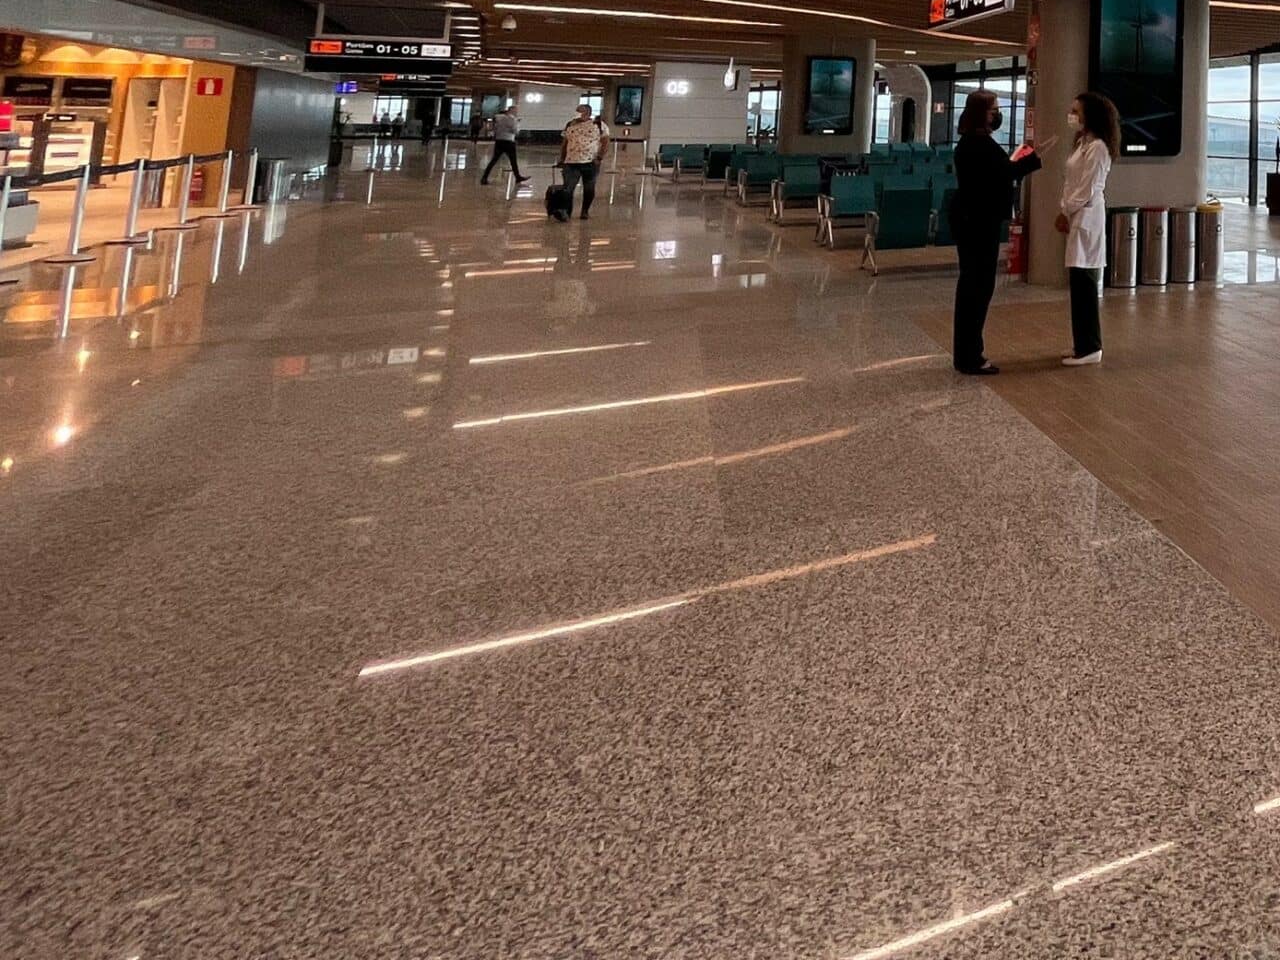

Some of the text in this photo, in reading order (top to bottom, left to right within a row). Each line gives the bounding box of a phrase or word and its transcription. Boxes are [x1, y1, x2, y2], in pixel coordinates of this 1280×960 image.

[376, 44, 391, 54] 01
[401, 45, 419, 55] 05
[667, 80, 689, 95] 05
